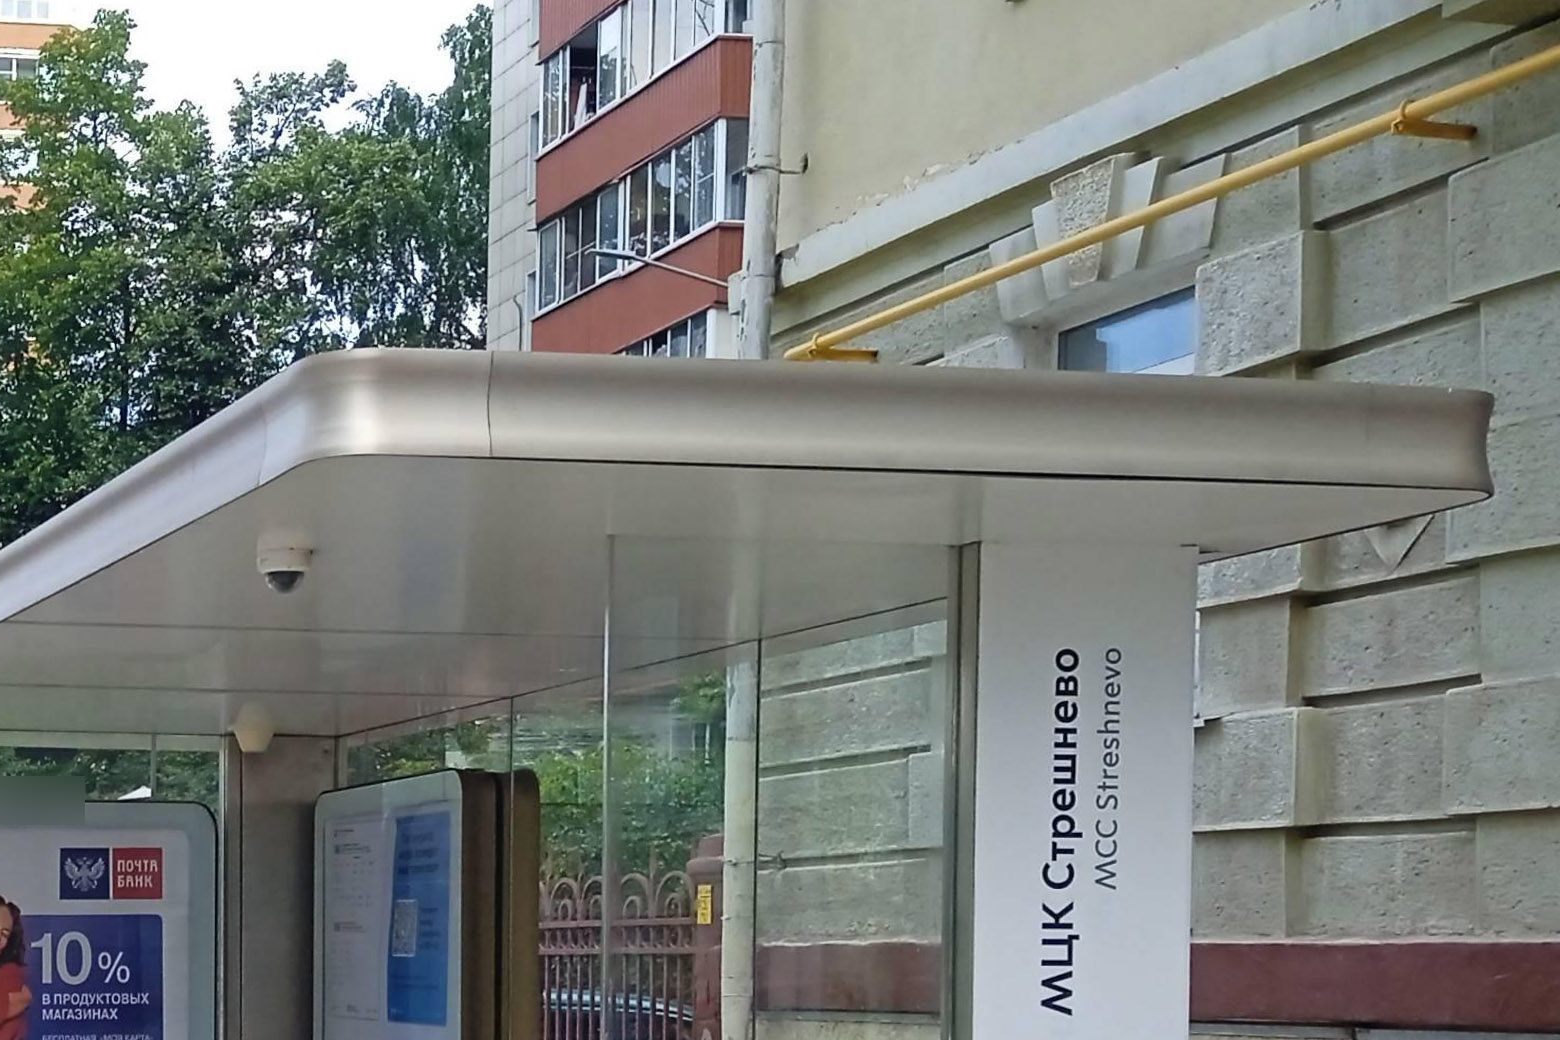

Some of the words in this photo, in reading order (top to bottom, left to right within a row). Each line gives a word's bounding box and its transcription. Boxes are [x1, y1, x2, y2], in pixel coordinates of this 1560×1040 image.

[1096, 647, 1122, 810] Streshnevo
[1042, 648, 1083, 890] Стрешнево
[117, 860, 158, 872] ПОЧТА
[1095, 820, 1117, 890] MCC
[117, 875, 153, 888] БАНК
[1041, 902, 1080, 1016] МЦК
[42, 993, 50, 1005] В
[53, 993, 149, 1006] ПРОДУКТОВЫХ
[42, 1009, 118, 1020] МАГАЗИНАХ
